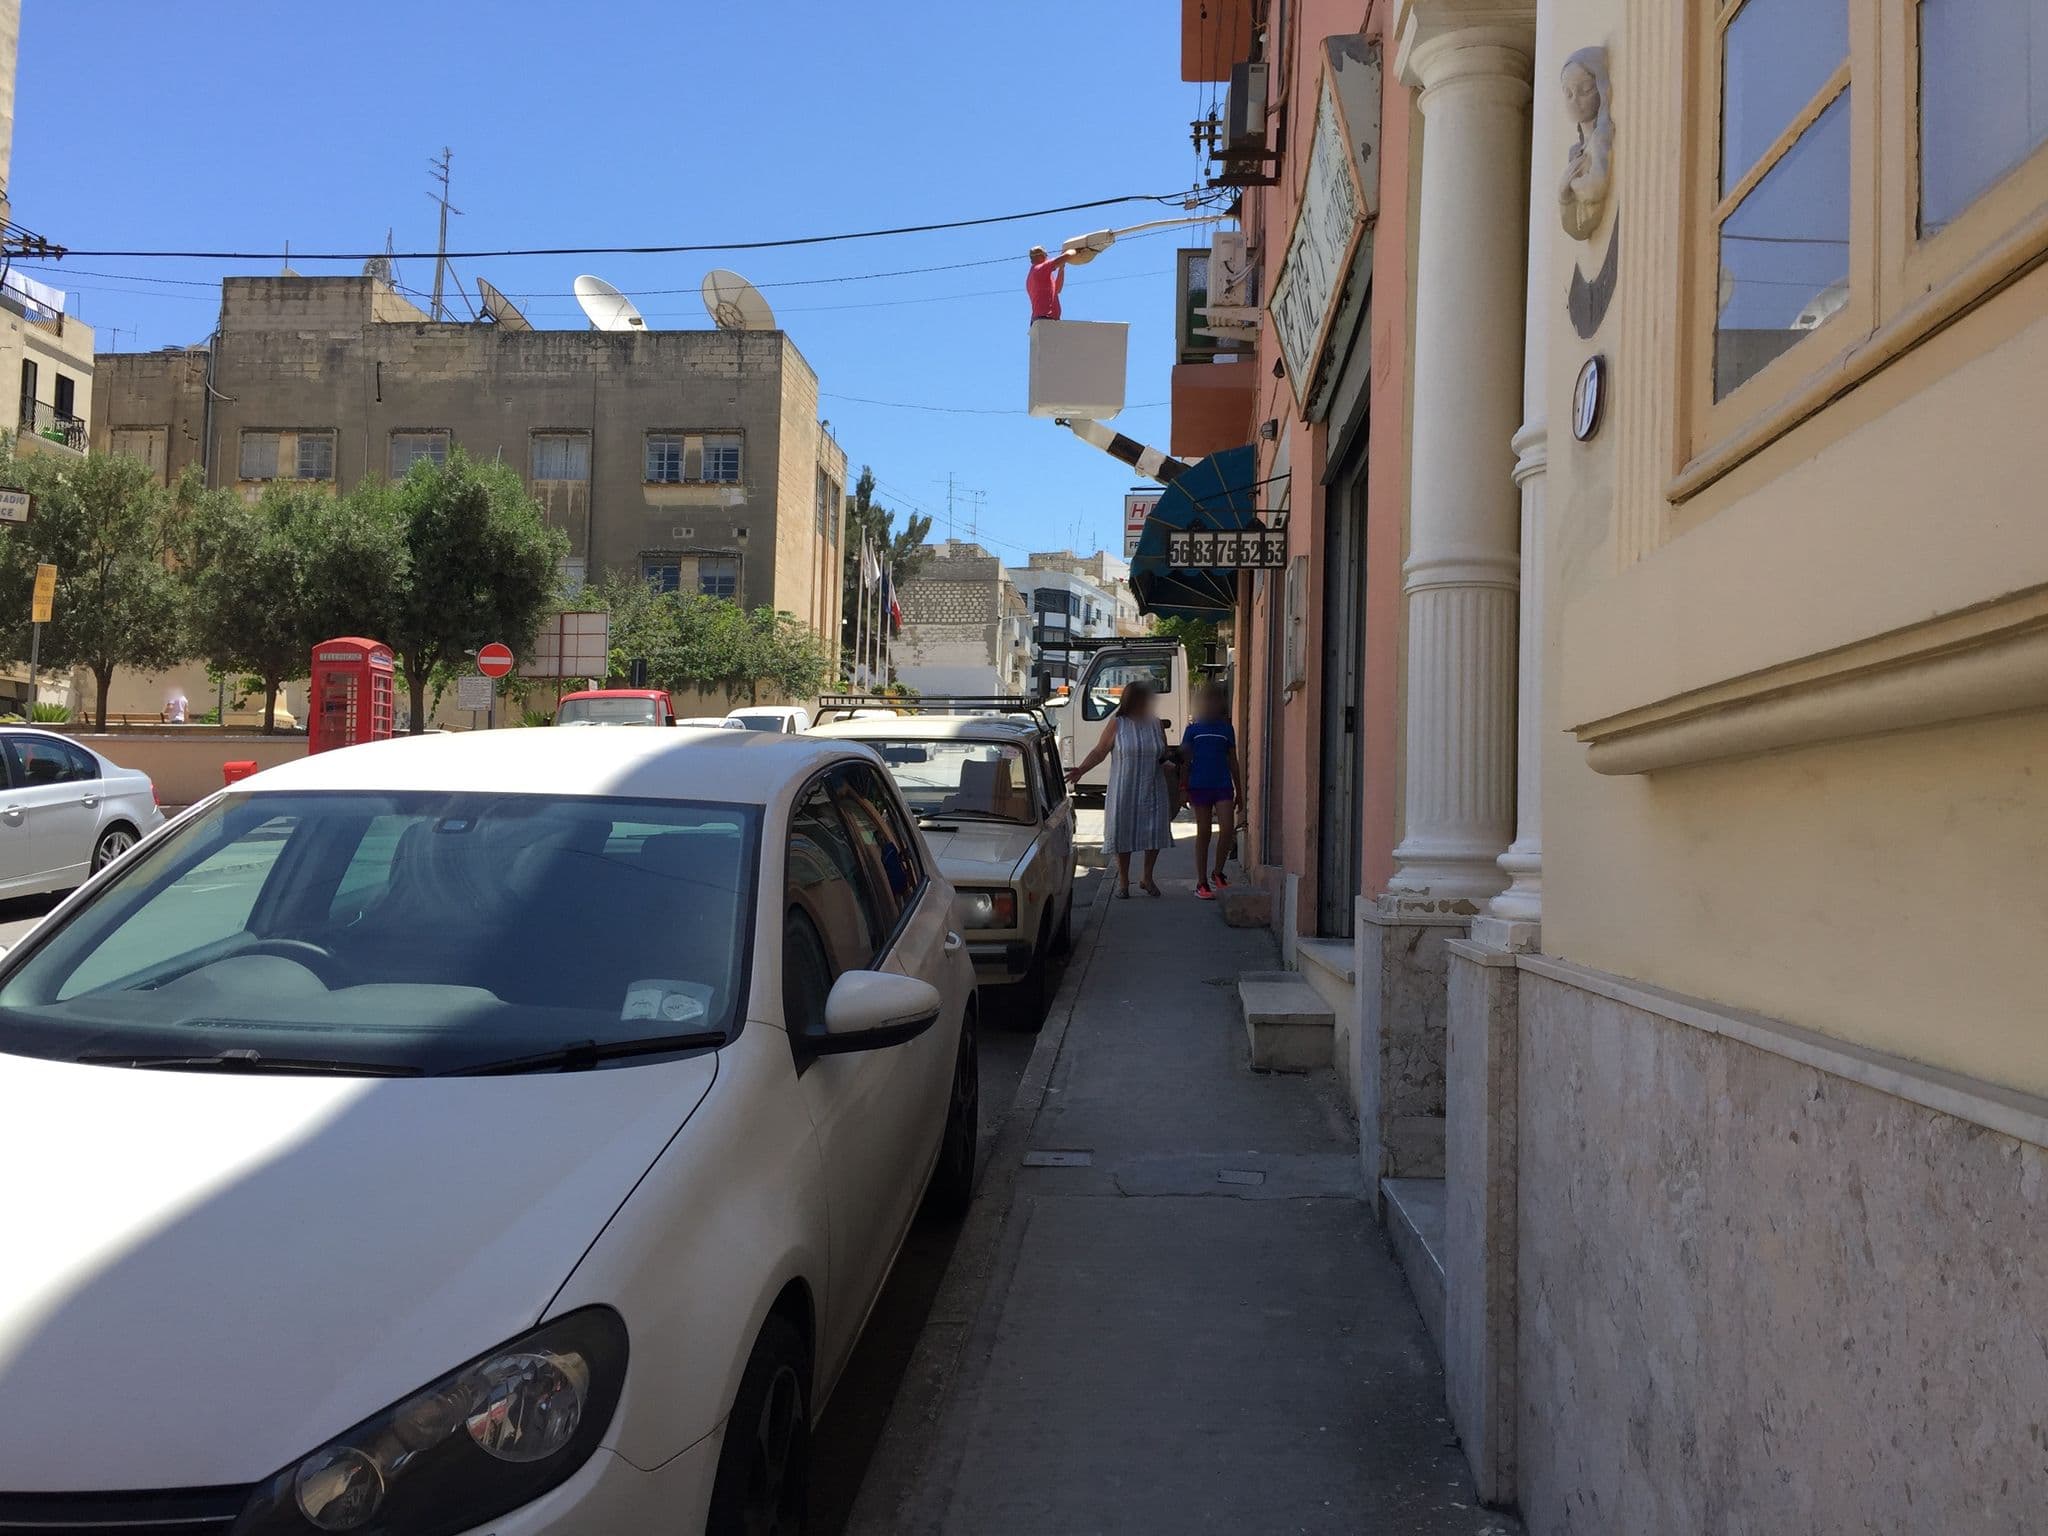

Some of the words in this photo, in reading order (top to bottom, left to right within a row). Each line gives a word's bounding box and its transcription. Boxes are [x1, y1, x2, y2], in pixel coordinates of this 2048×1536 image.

[1170, 540, 1190, 563] 56
[1217, 541, 1237, 563] 75
[1240, 541, 1261, 563] 52
